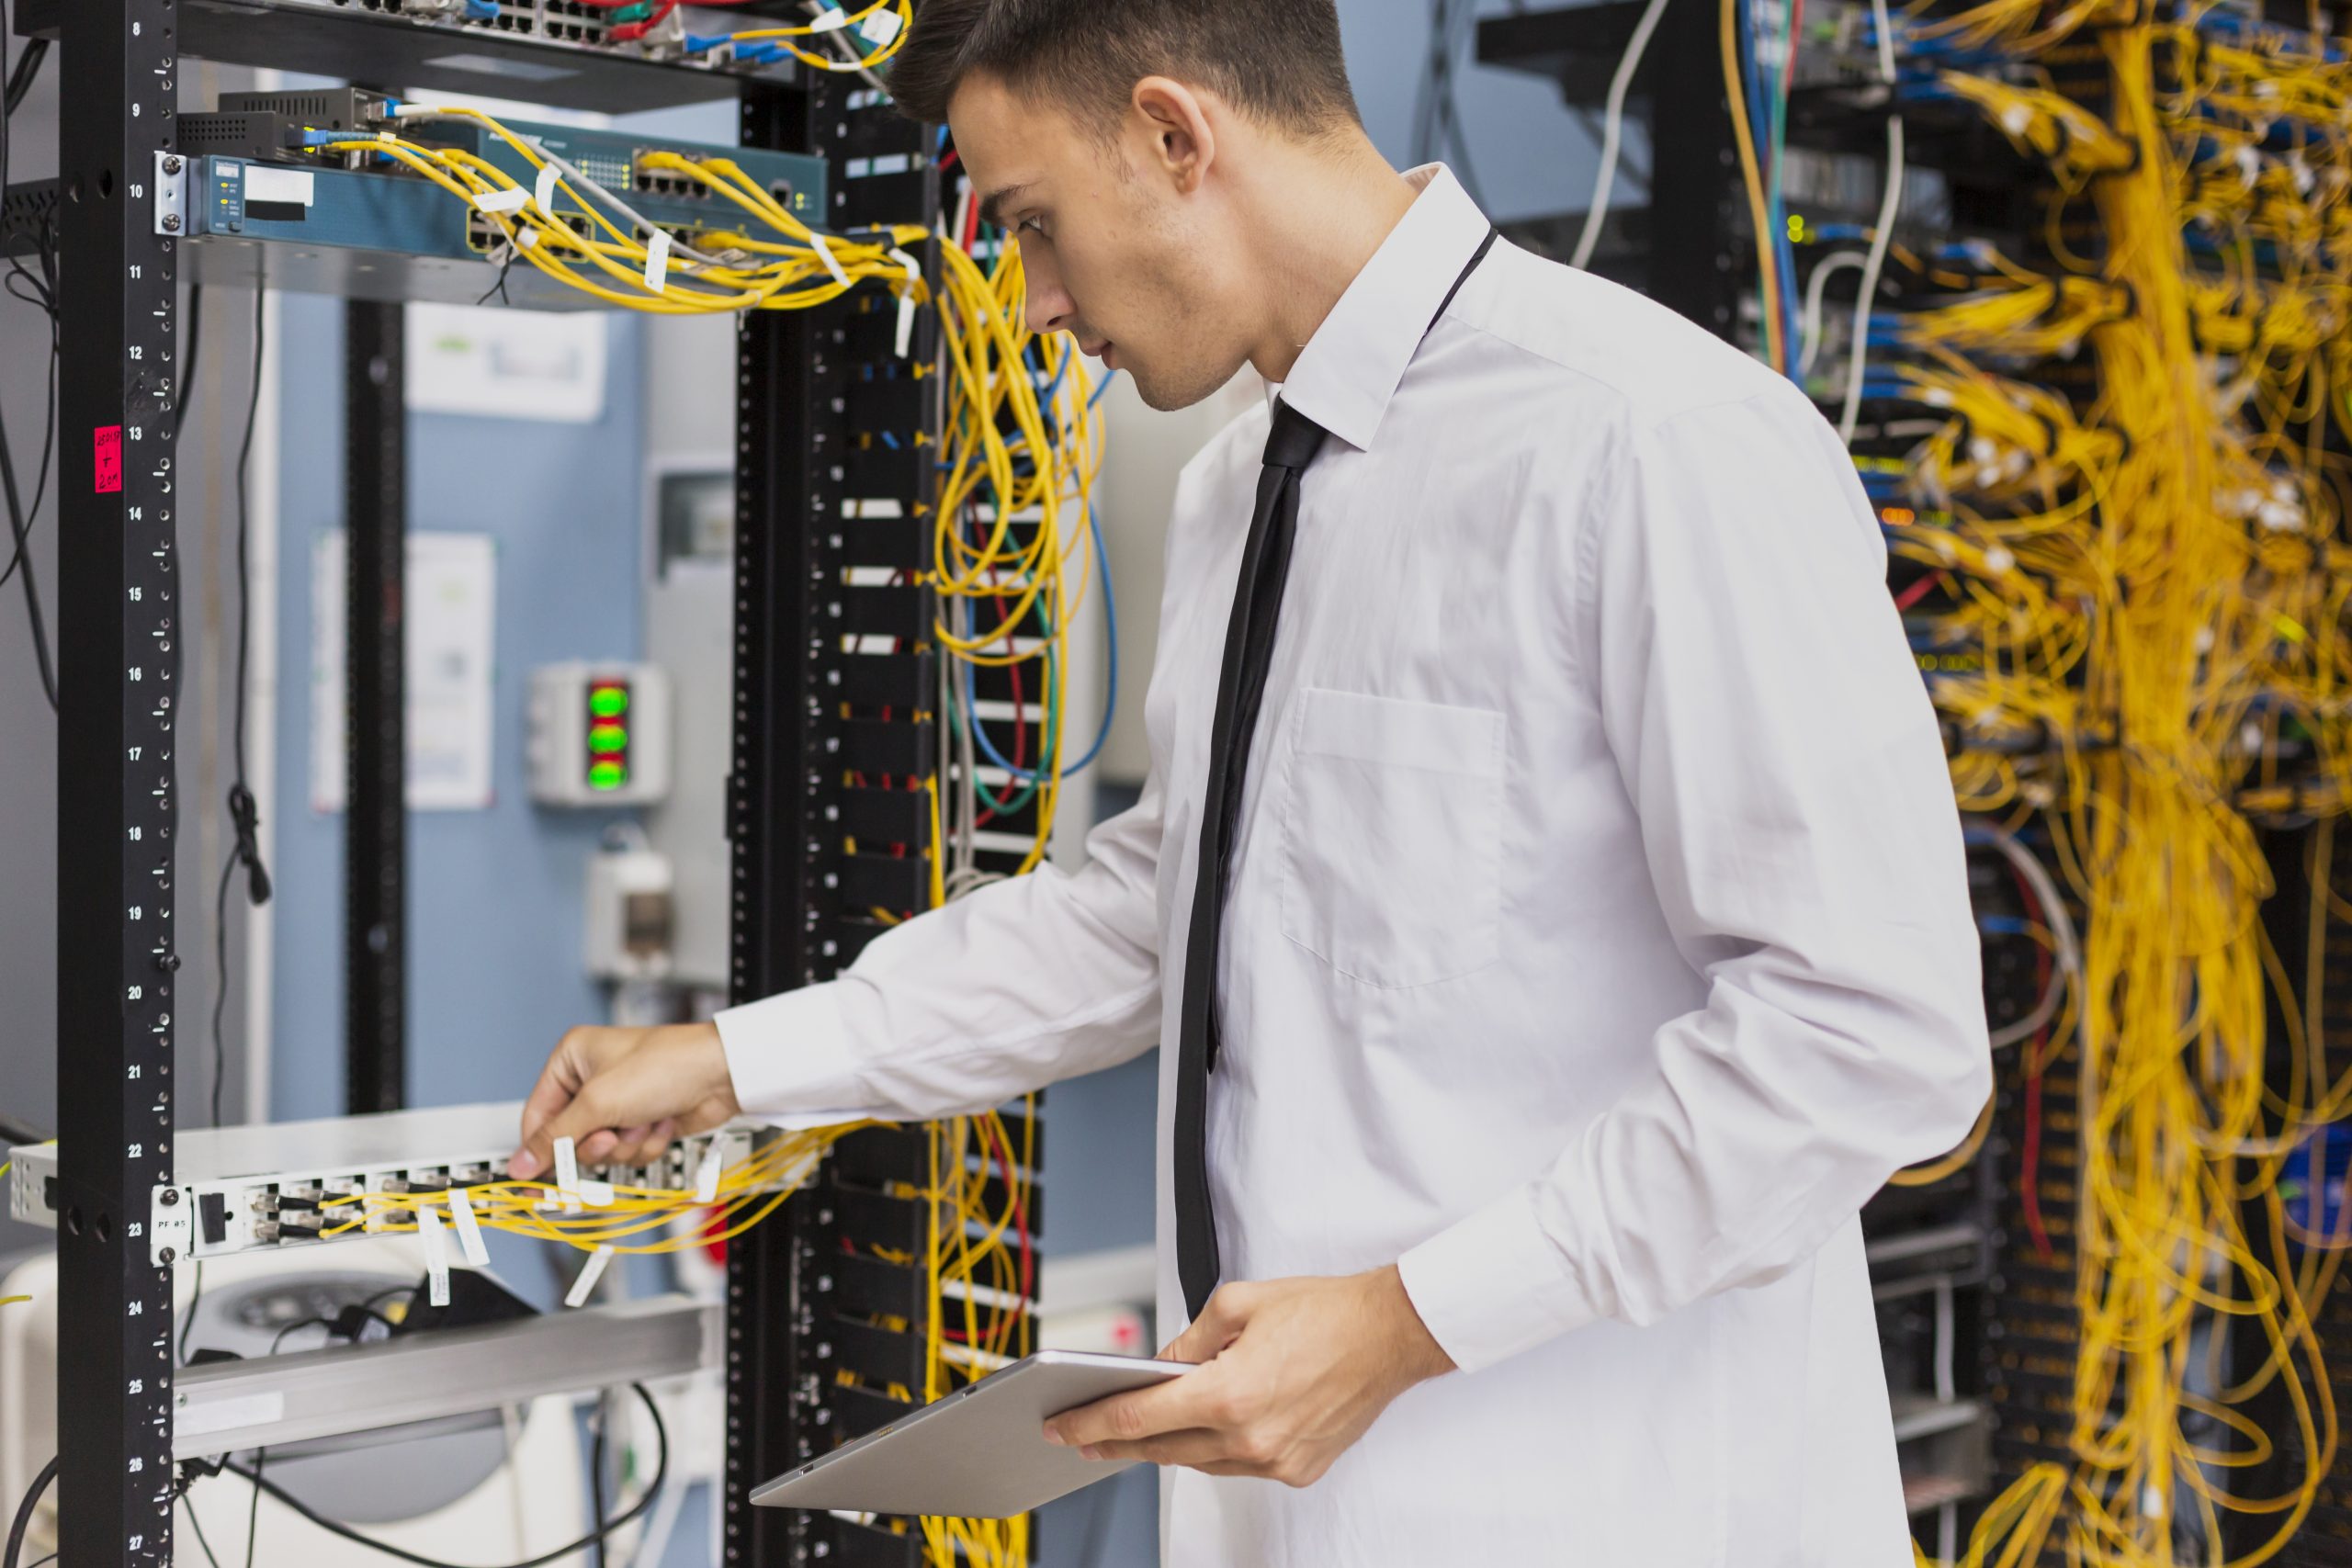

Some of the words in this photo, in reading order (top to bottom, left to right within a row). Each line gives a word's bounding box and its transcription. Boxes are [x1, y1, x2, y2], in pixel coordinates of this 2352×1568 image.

[132, 21, 141, 37] 8
[131, 102, 141, 118] 9
[129, 184, 143, 199] 10
[129, 265, 141, 279] 11
[129, 345, 142, 360] 12
[128, 425, 142, 441] 13
[128, 506, 142, 521] 14
[128, 586, 142, 602] 15
[128, 666, 142, 682] 16
[128, 746, 142, 761] 17
[128, 826, 142, 841] 18
[128, 906, 142, 920] 19
[128, 985, 142, 1000] 20
[128, 1064, 141, 1079] 21
[128, 1143, 142, 1158] 22
[128, 1222, 142, 1237] 23
[128, 1300, 143, 1316] 24
[128, 1378, 143, 1394] 25
[129, 1456, 143, 1473] 26
[129, 1534, 143, 1551] 27
